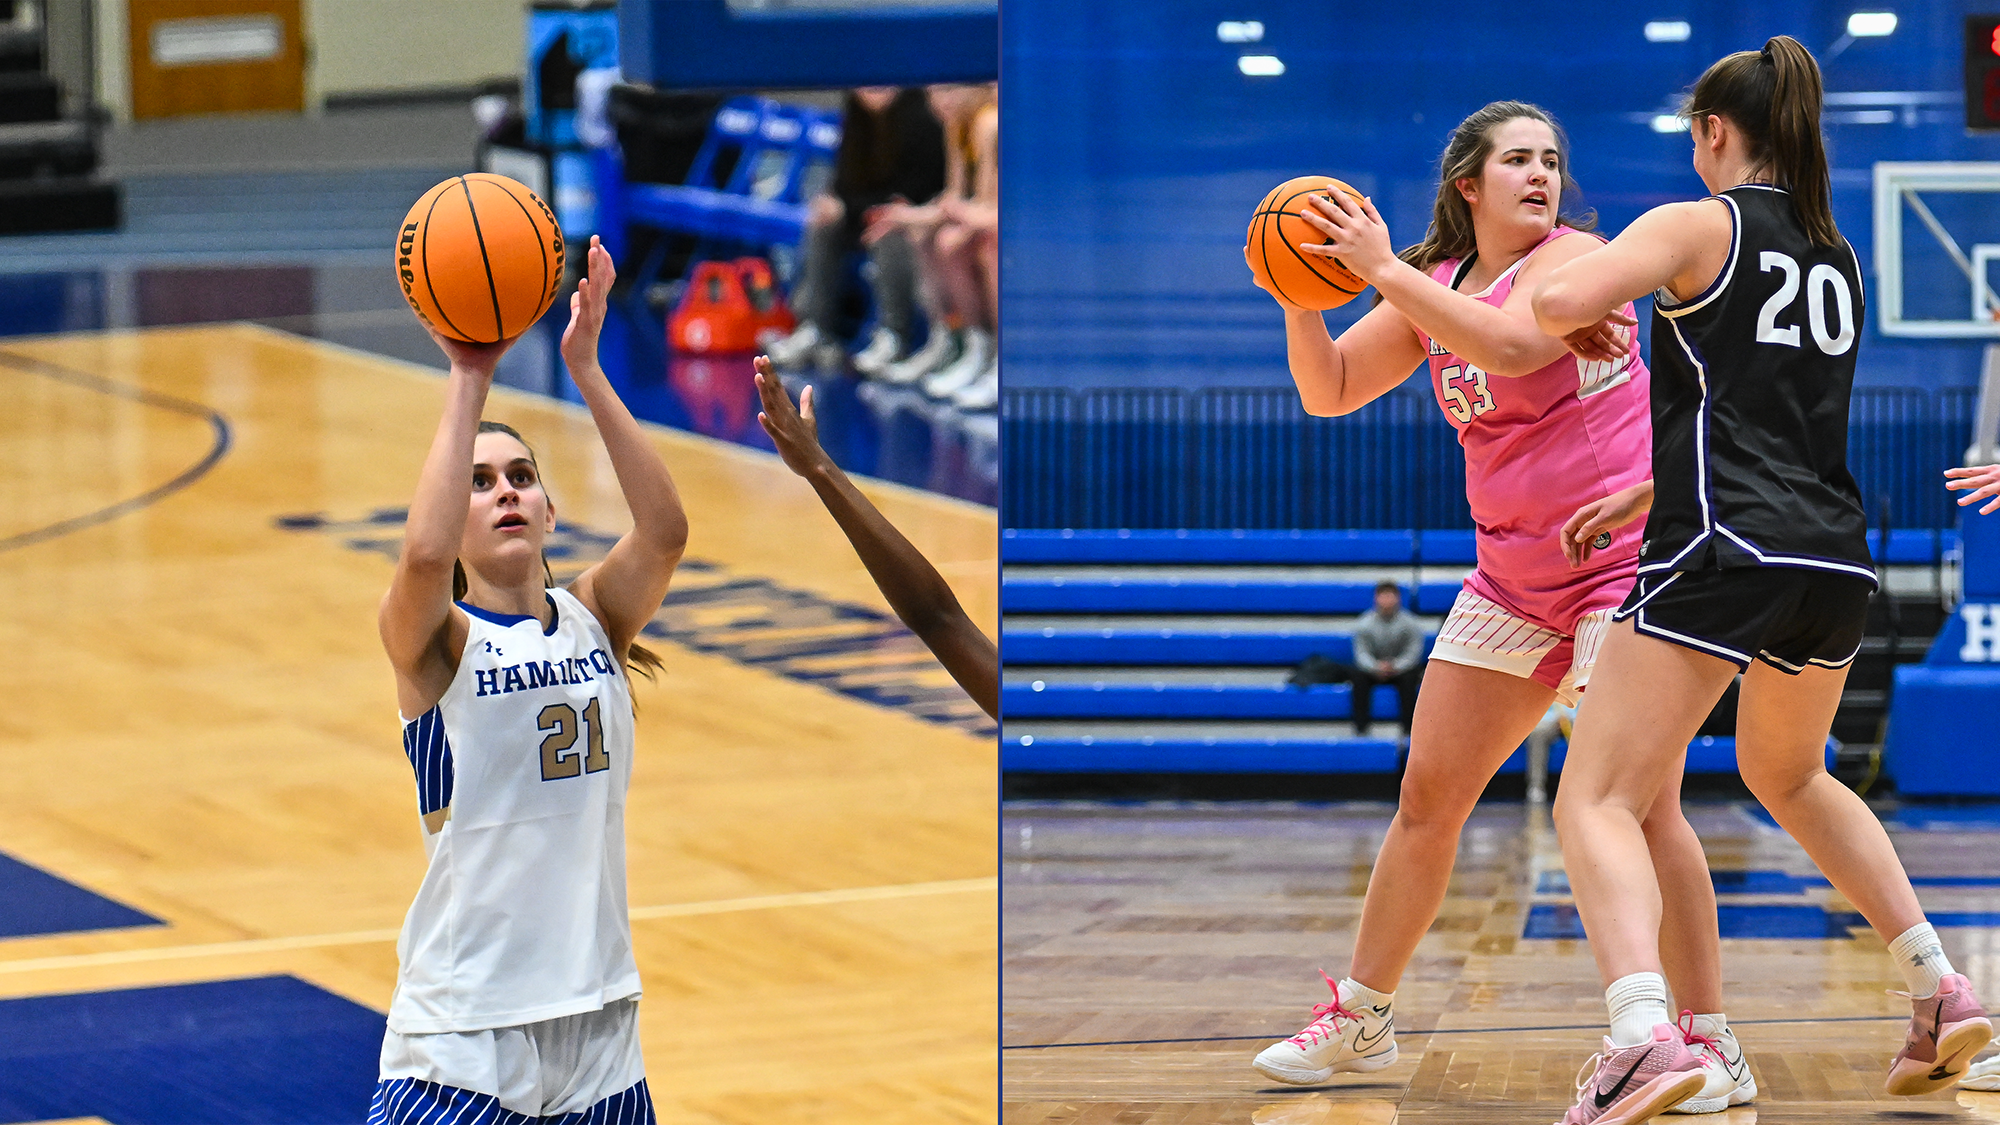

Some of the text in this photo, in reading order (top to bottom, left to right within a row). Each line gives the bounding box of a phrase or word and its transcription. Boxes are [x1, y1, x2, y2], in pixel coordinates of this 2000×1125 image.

[1756, 251, 1855, 356] 20
[1441, 363, 1497, 423] 53
[475, 648, 616, 696] HAMILTO
[536, 696, 610, 782] 21
